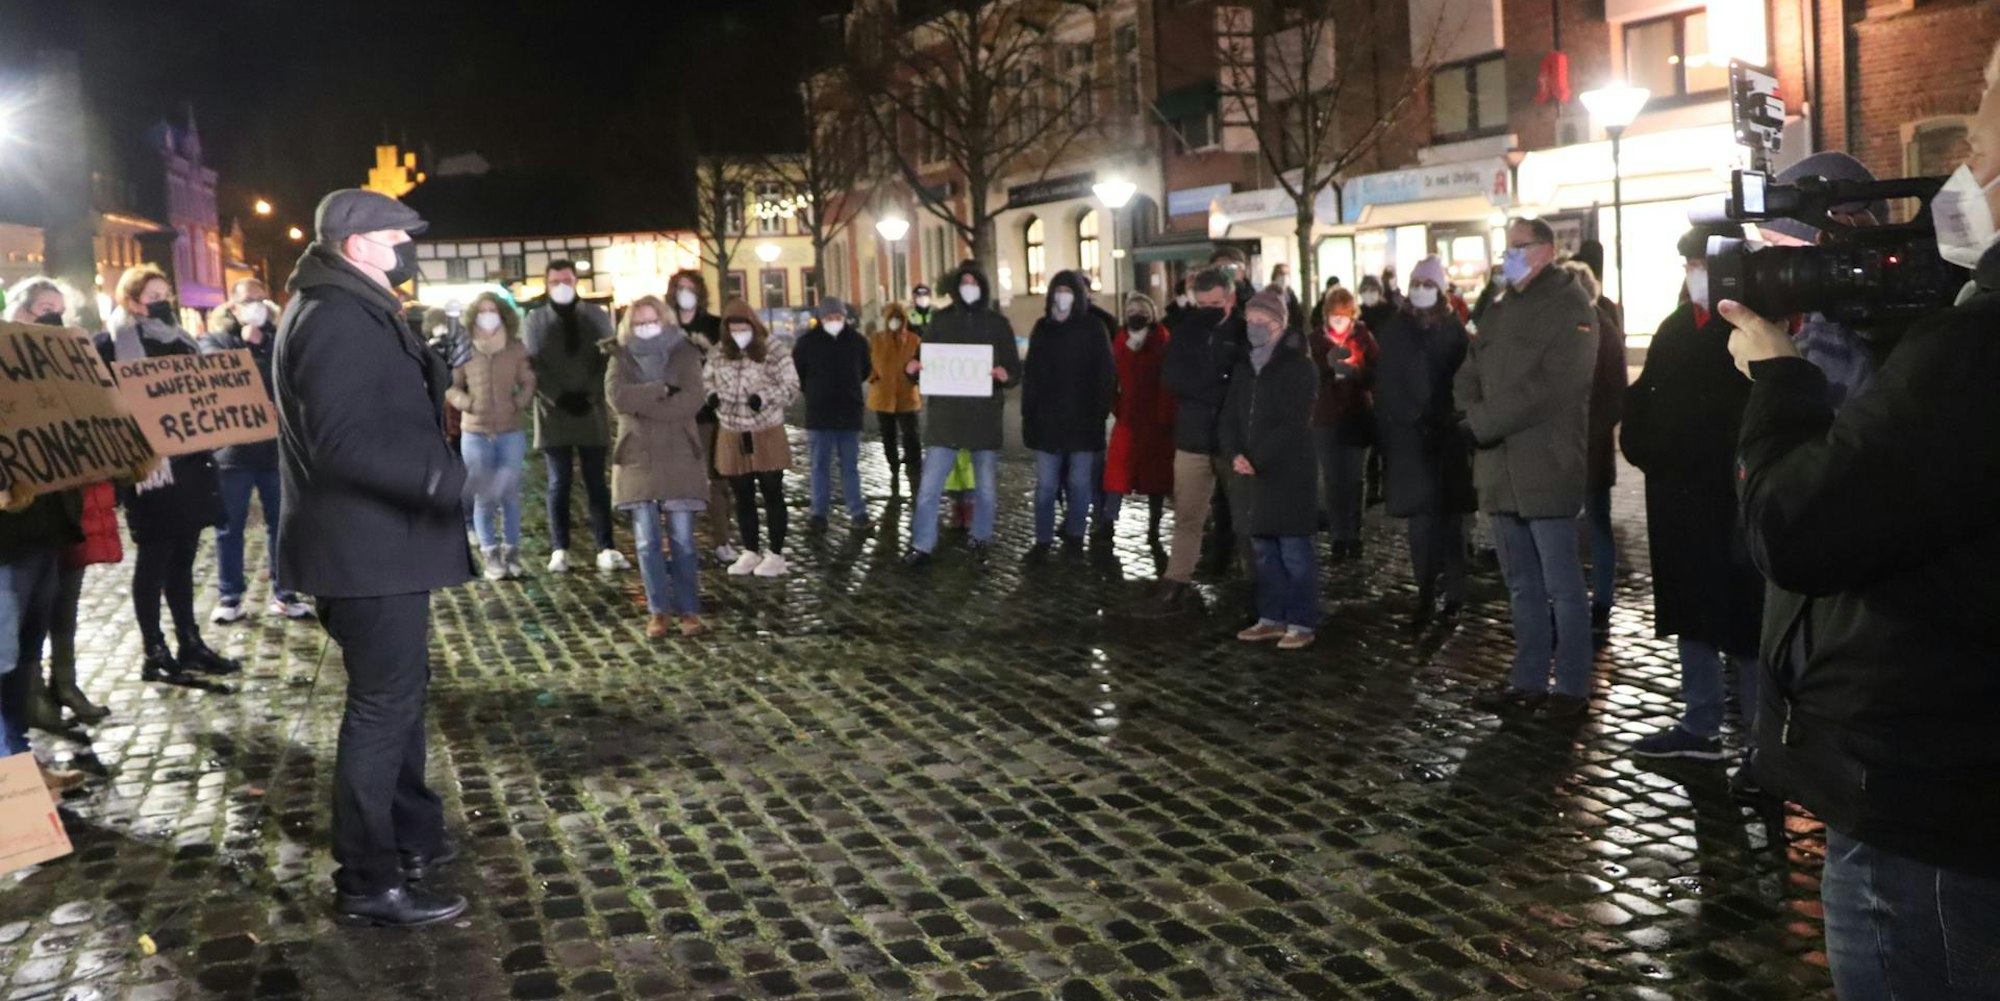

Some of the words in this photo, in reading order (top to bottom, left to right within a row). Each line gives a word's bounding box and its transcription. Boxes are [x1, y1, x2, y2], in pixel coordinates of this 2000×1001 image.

[120, 353, 242, 378] DEMOKRATEN
[145, 374, 207, 398] LAUFEN
[209, 369, 251, 390] NICHT
[189, 393, 218, 410] MIT
[160, 403, 268, 444] RECHTEN
[0, 413, 155, 490] RONATOTEN
